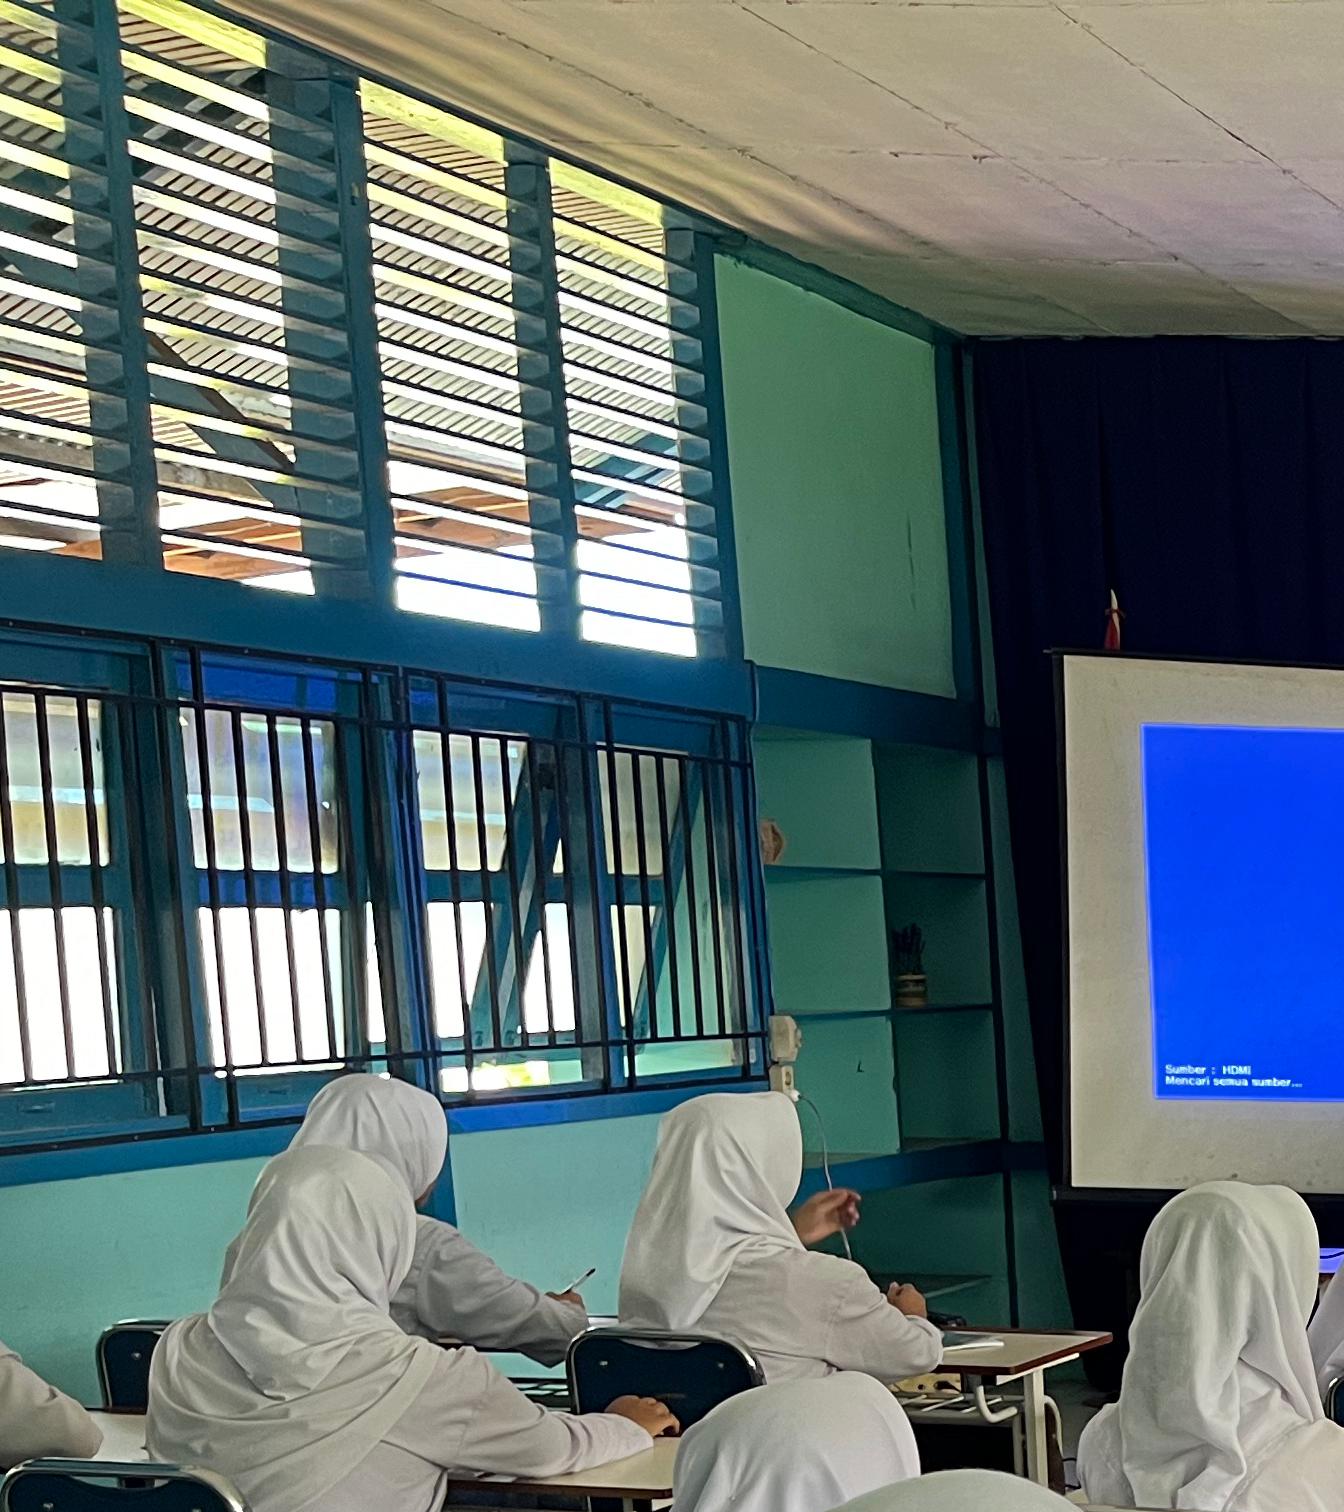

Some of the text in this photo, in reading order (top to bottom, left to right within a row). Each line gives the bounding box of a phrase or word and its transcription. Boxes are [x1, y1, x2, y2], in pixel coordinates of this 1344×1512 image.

[1165, 1064, 1206, 1075] Sumber
[1222, 1065, 1251, 1075] HDMI
[1165, 1076, 1210, 1086] Mencari
[1213, 1077, 1249, 1087] semua
